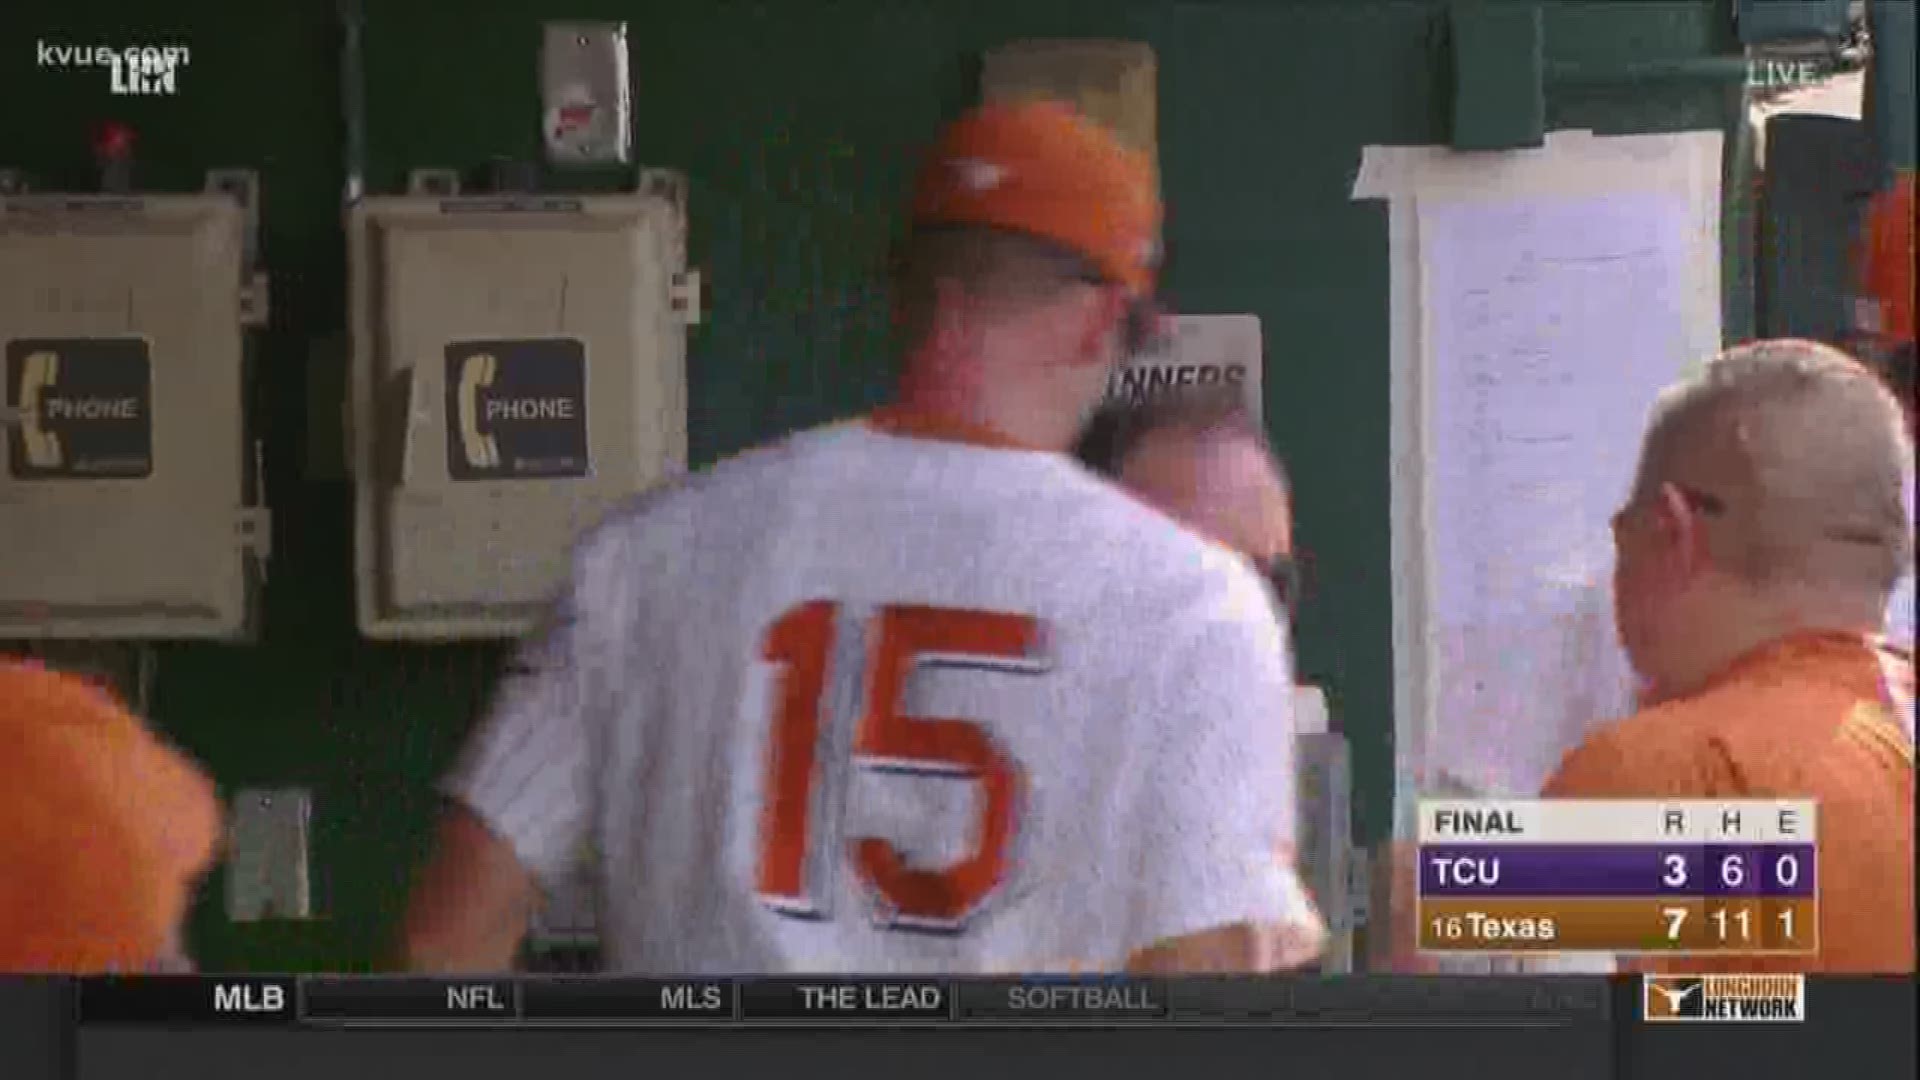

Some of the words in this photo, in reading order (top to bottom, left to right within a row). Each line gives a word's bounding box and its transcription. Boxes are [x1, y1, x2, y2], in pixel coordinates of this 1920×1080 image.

[46, 397, 139, 419] PHONE
[486, 397, 574, 419] PHONE
[755, 598, 1050, 934] 15
